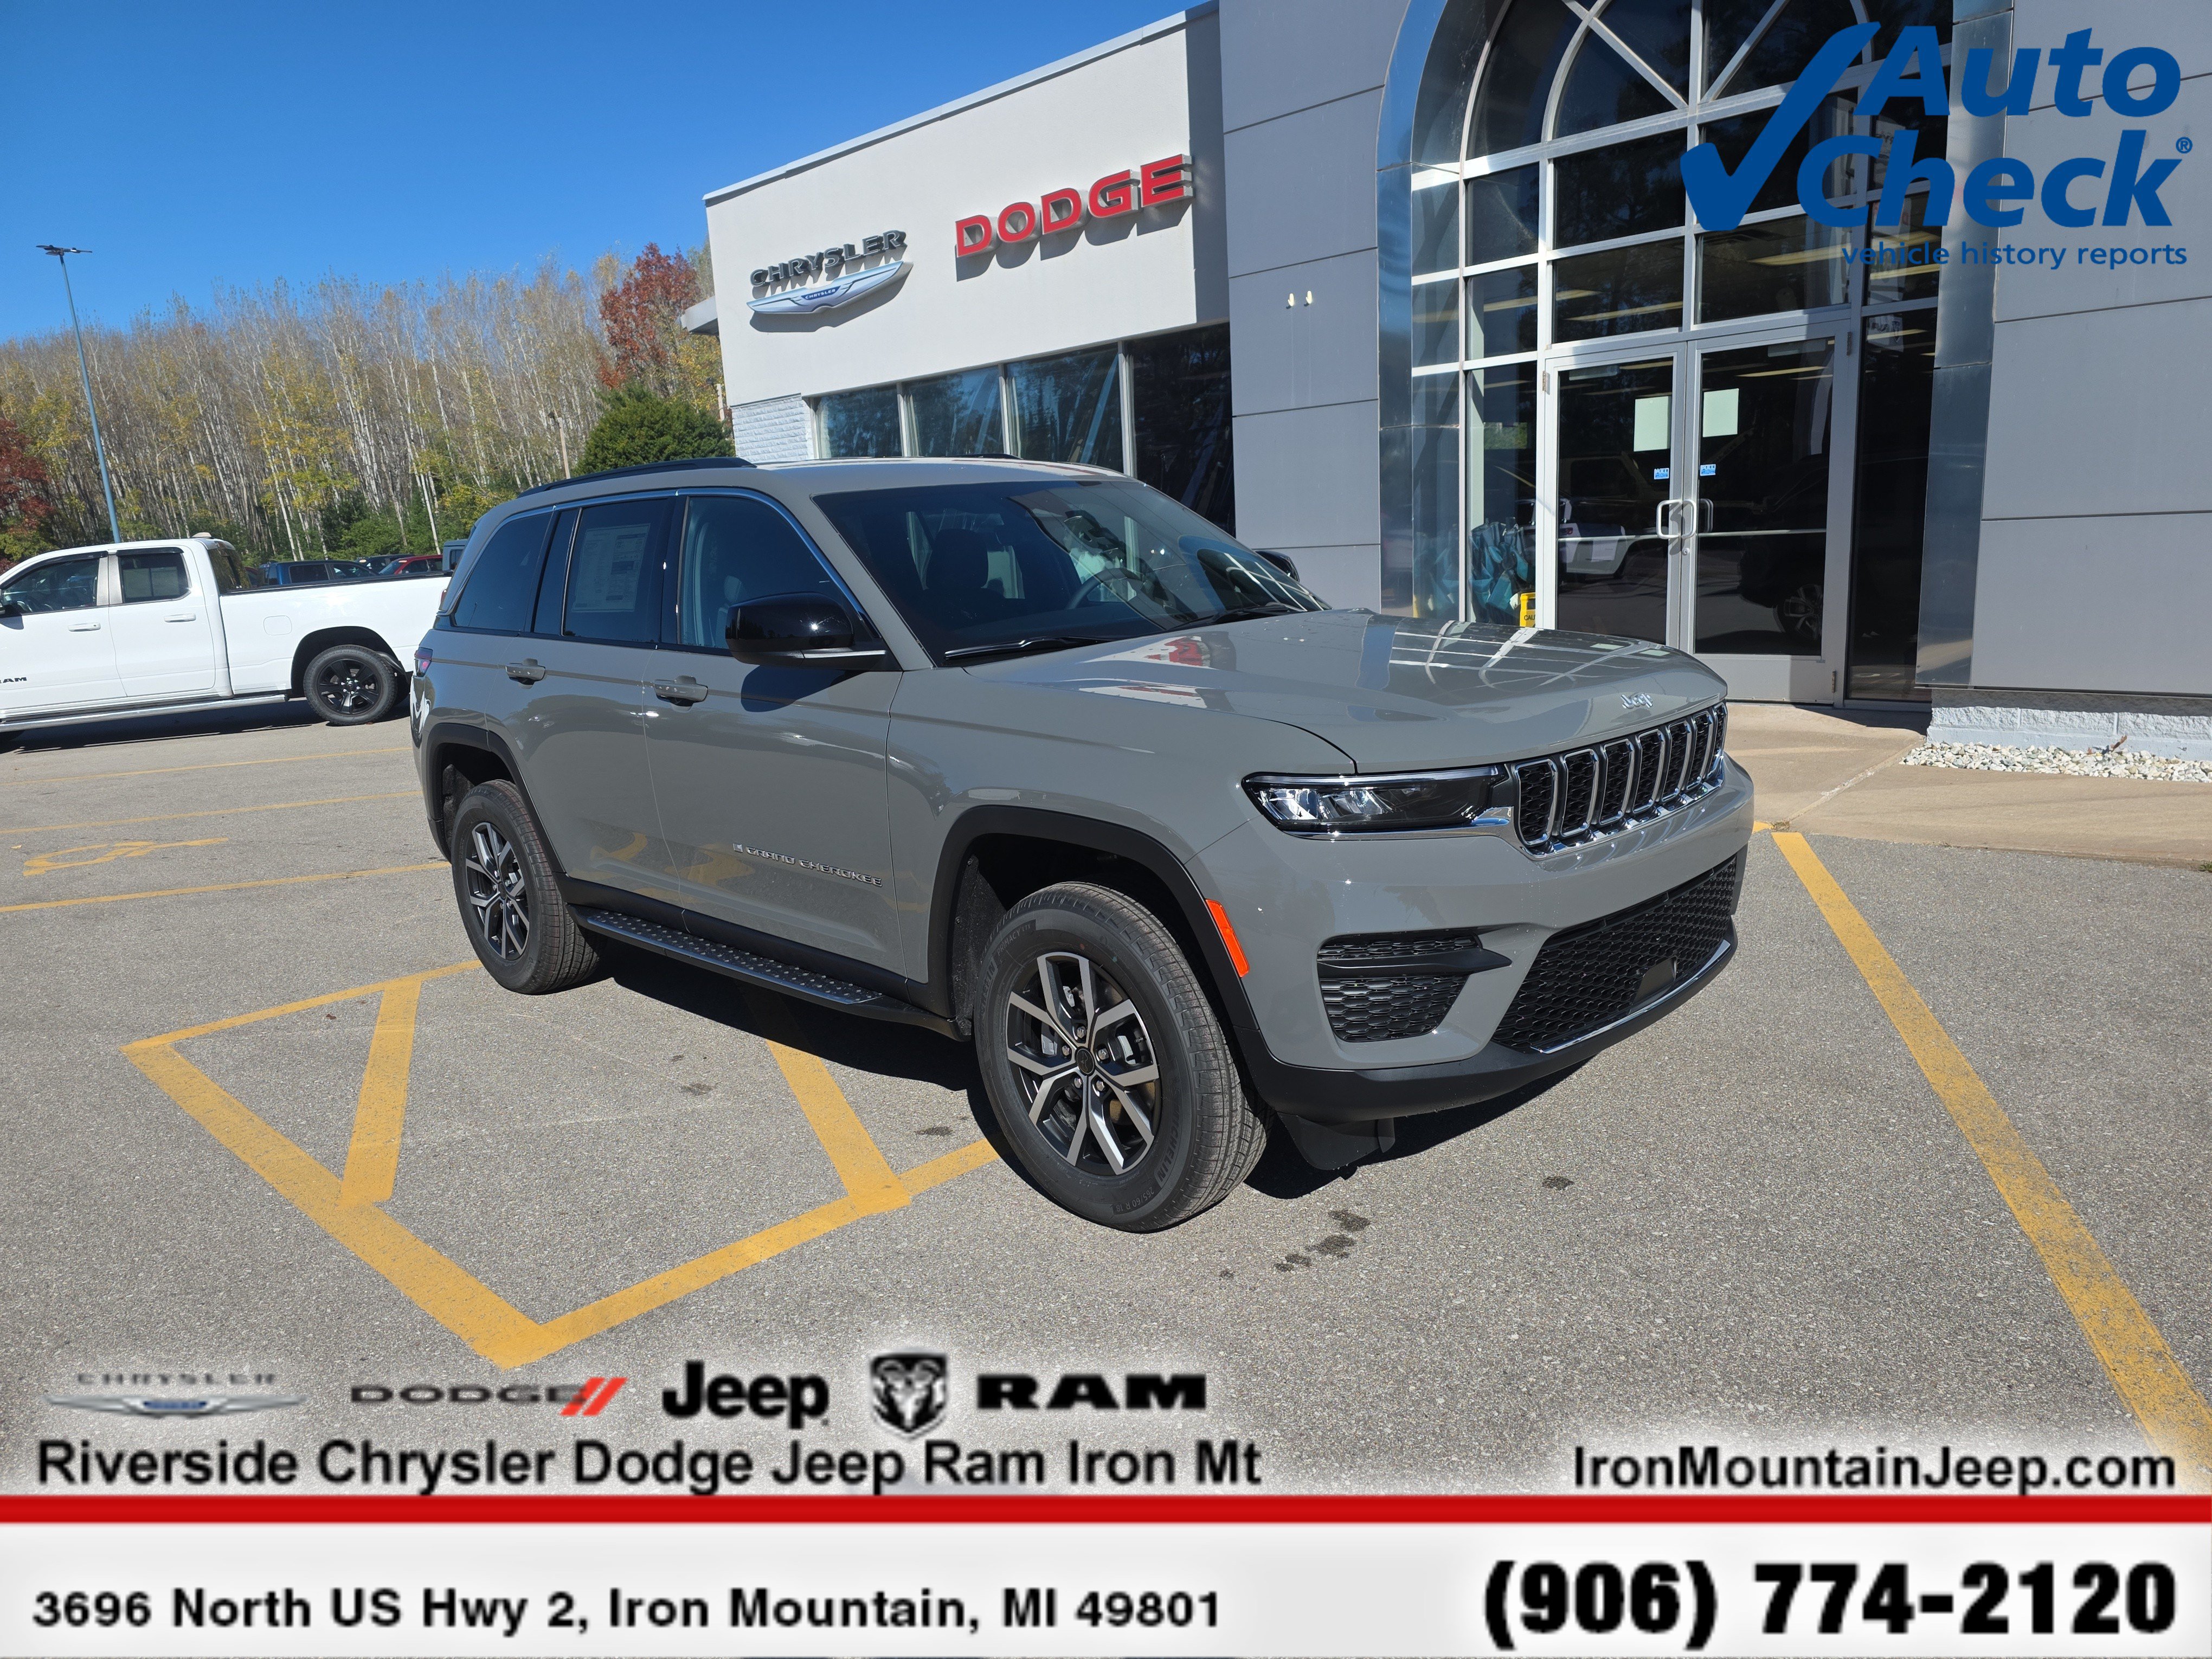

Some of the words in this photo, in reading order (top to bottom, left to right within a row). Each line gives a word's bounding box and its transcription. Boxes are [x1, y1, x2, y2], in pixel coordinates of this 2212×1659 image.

[955, 154, 1187, 258] DODGE
[750, 230, 906, 287] CHRYSLER
[805, 288, 835, 299] CHRYSLER
[1620, 693, 1653, 709] Jeep
[745, 846, 795, 865] GRAND
[799, 859, 883, 888] CHEROKEE
[996, 929, 1020, 956] PRIMACY
[1132, 1186, 1155, 1208] 265/60
